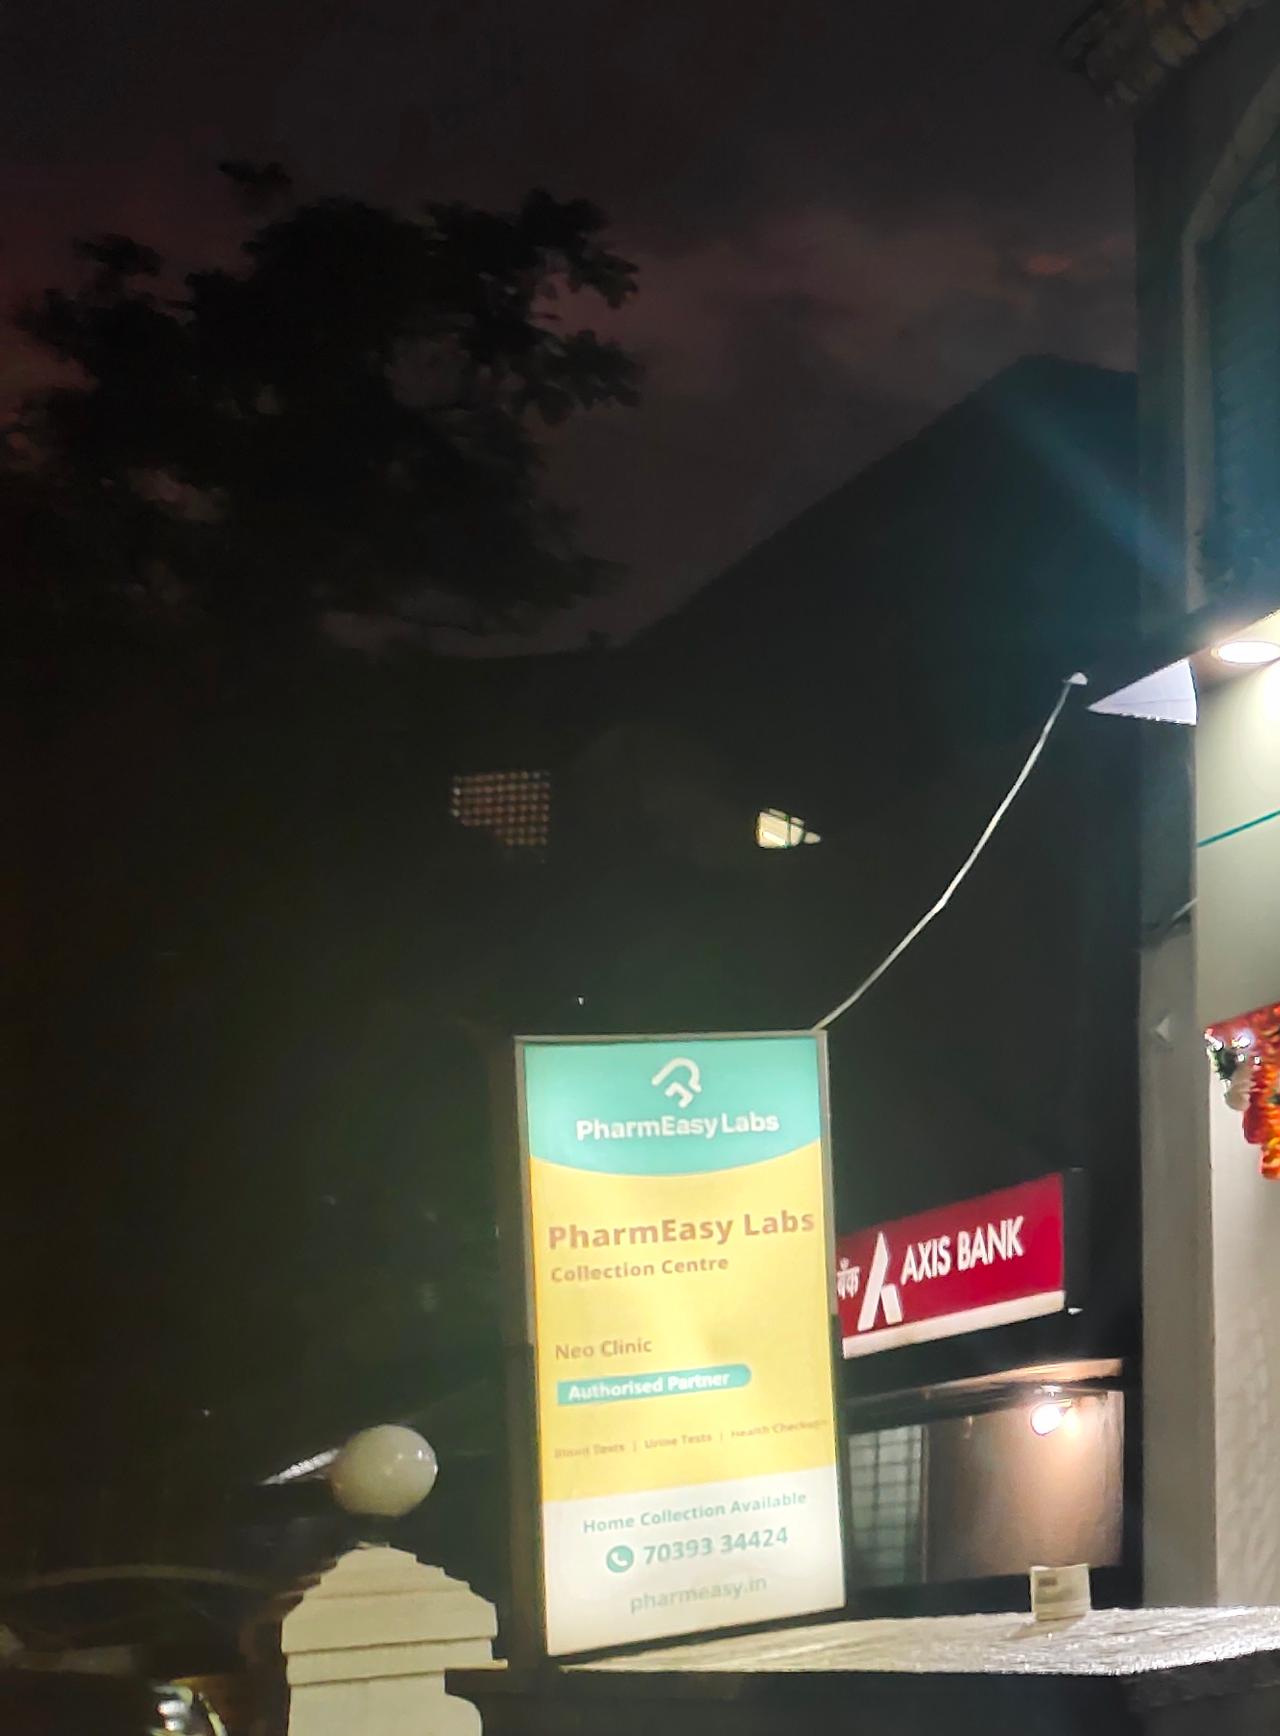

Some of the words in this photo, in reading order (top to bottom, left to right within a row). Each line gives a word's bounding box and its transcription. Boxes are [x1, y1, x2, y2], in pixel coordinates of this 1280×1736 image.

[576, 1115, 717, 1141] PharmEasy
[721, 1111, 780, 1134] Labs
[549, 1217, 733, 1251] PharmEasy
[743, 1209, 815, 1237] Labs
[901, 1235, 951, 1286] AXIS
[957, 1215, 1024, 1272] BANK
[551, 1261, 655, 1284] Collection
[661, 1256, 729, 1275] Centre
[555, 1343, 594, 1361] Neo
[600, 1337, 653, 1358] Clinic
[568, 1377, 663, 1400] Authorised
[667, 1371, 731, 1392] Partner
[644, 1437, 677, 1450] Urine
[682, 1433, 713, 1445] Tests
[731, 1426, 770, 1439] Health
[583, 1516, 635, 1534] Home
[640, 1502, 726, 1527] Collection
[730, 1492, 808, 1514] Available
[643, 1537, 713, 1566] 70393
[720, 1526, 789, 1554] 34424
[630, 1576, 767, 1615] pharmeasy.in
